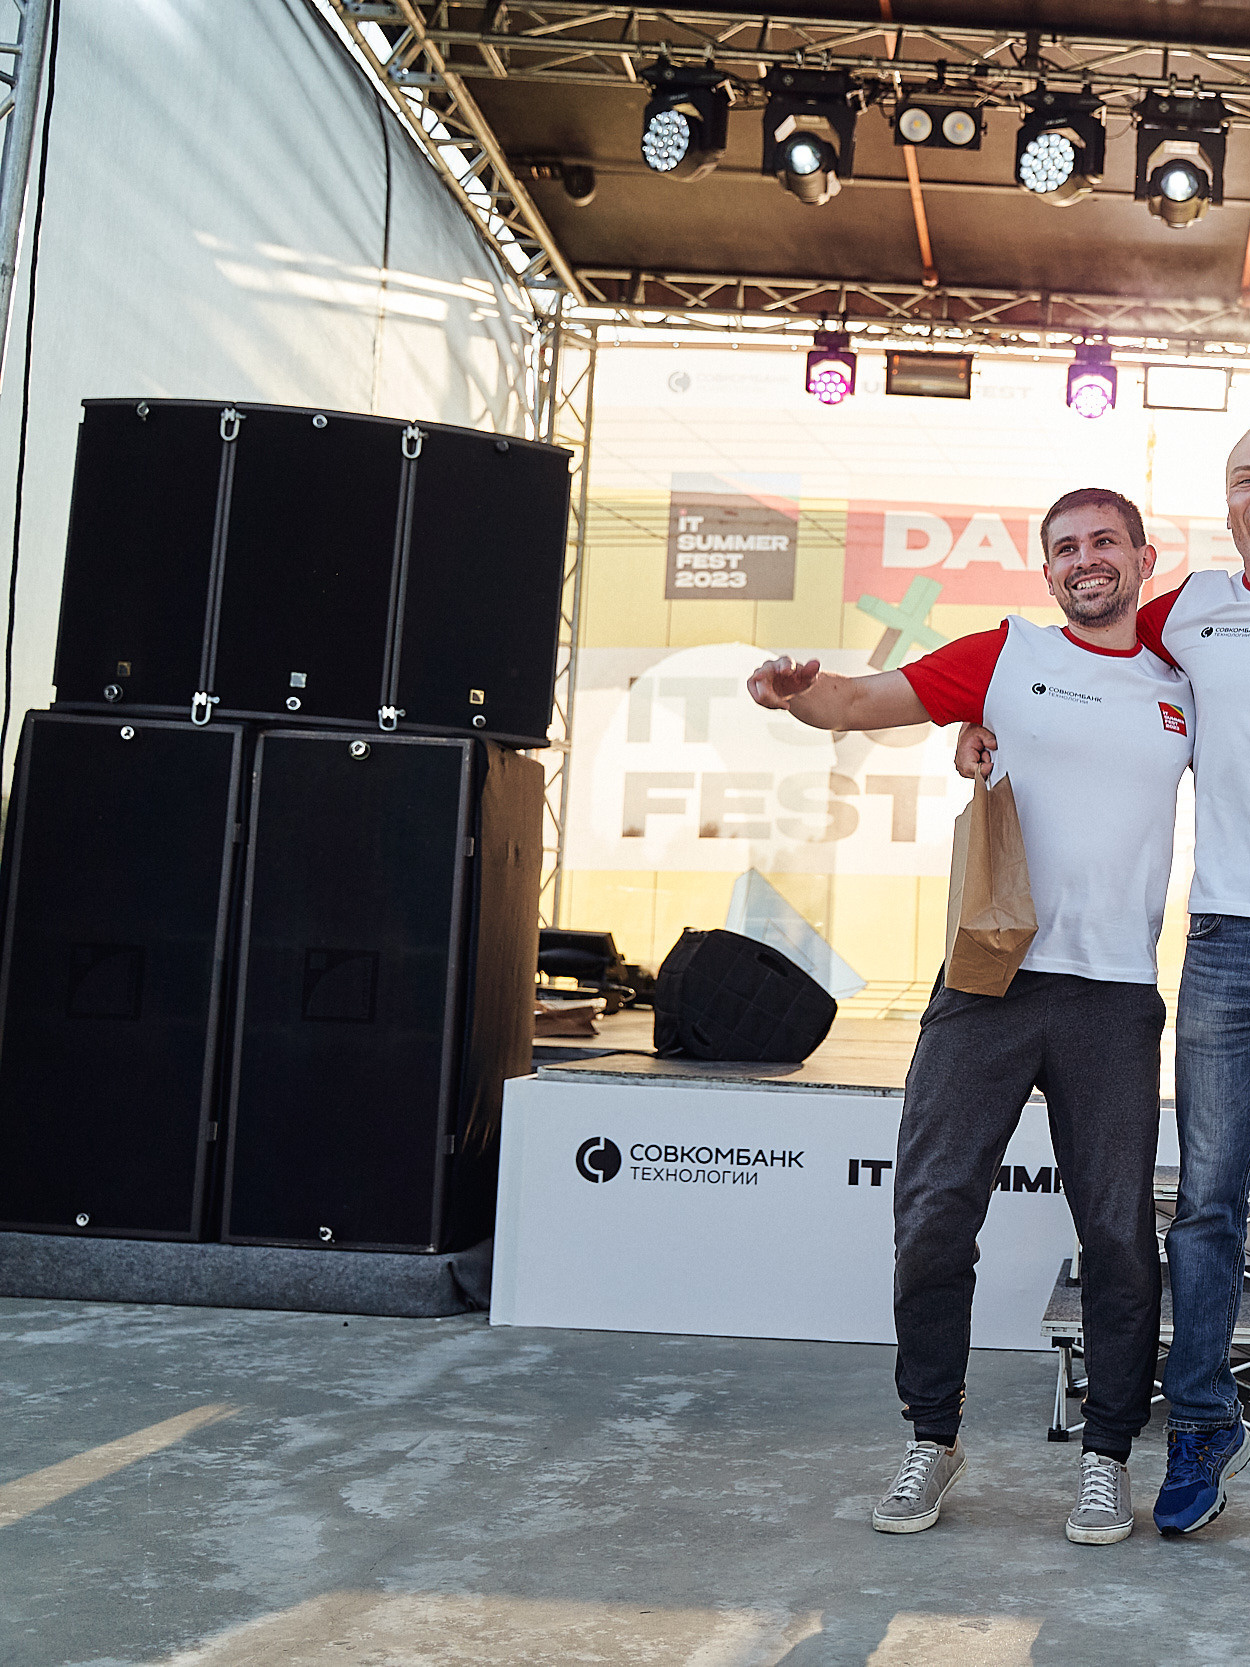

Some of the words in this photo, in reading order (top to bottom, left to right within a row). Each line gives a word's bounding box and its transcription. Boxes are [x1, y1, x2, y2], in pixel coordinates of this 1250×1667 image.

[676, 533, 790, 552] SUMMER
[675, 552, 744, 570] FEST
[674, 570, 748, 588] 2023
[1048, 686, 1103, 704] СОВКОМБАНК
[622, 771, 947, 843] FEST
[630, 1143, 805, 1168] СОВКОМБАНК
[630, 1166, 758, 1185] ТЕХНОЛОГИИ
[848, 1158, 893, 1187] IT
